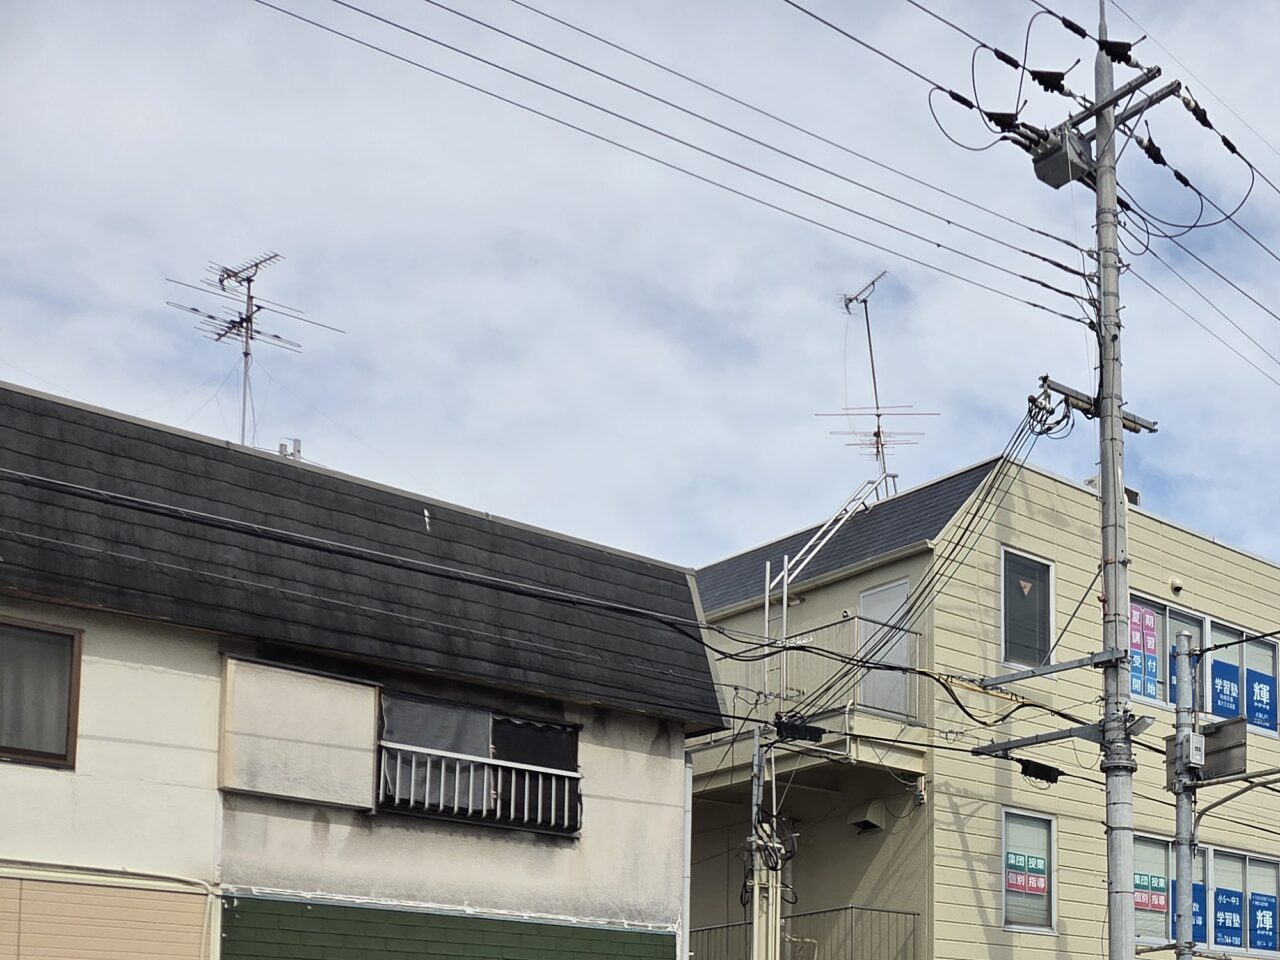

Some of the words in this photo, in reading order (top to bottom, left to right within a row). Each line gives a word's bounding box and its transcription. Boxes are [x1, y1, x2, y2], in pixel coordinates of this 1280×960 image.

[1214, 677, 1239, 698] 学習塾
[1253, 681, 1270, 704] 輝
[1216, 911, 1241, 928] 学習塾
[1256, 909, 1273, 930] 輝
